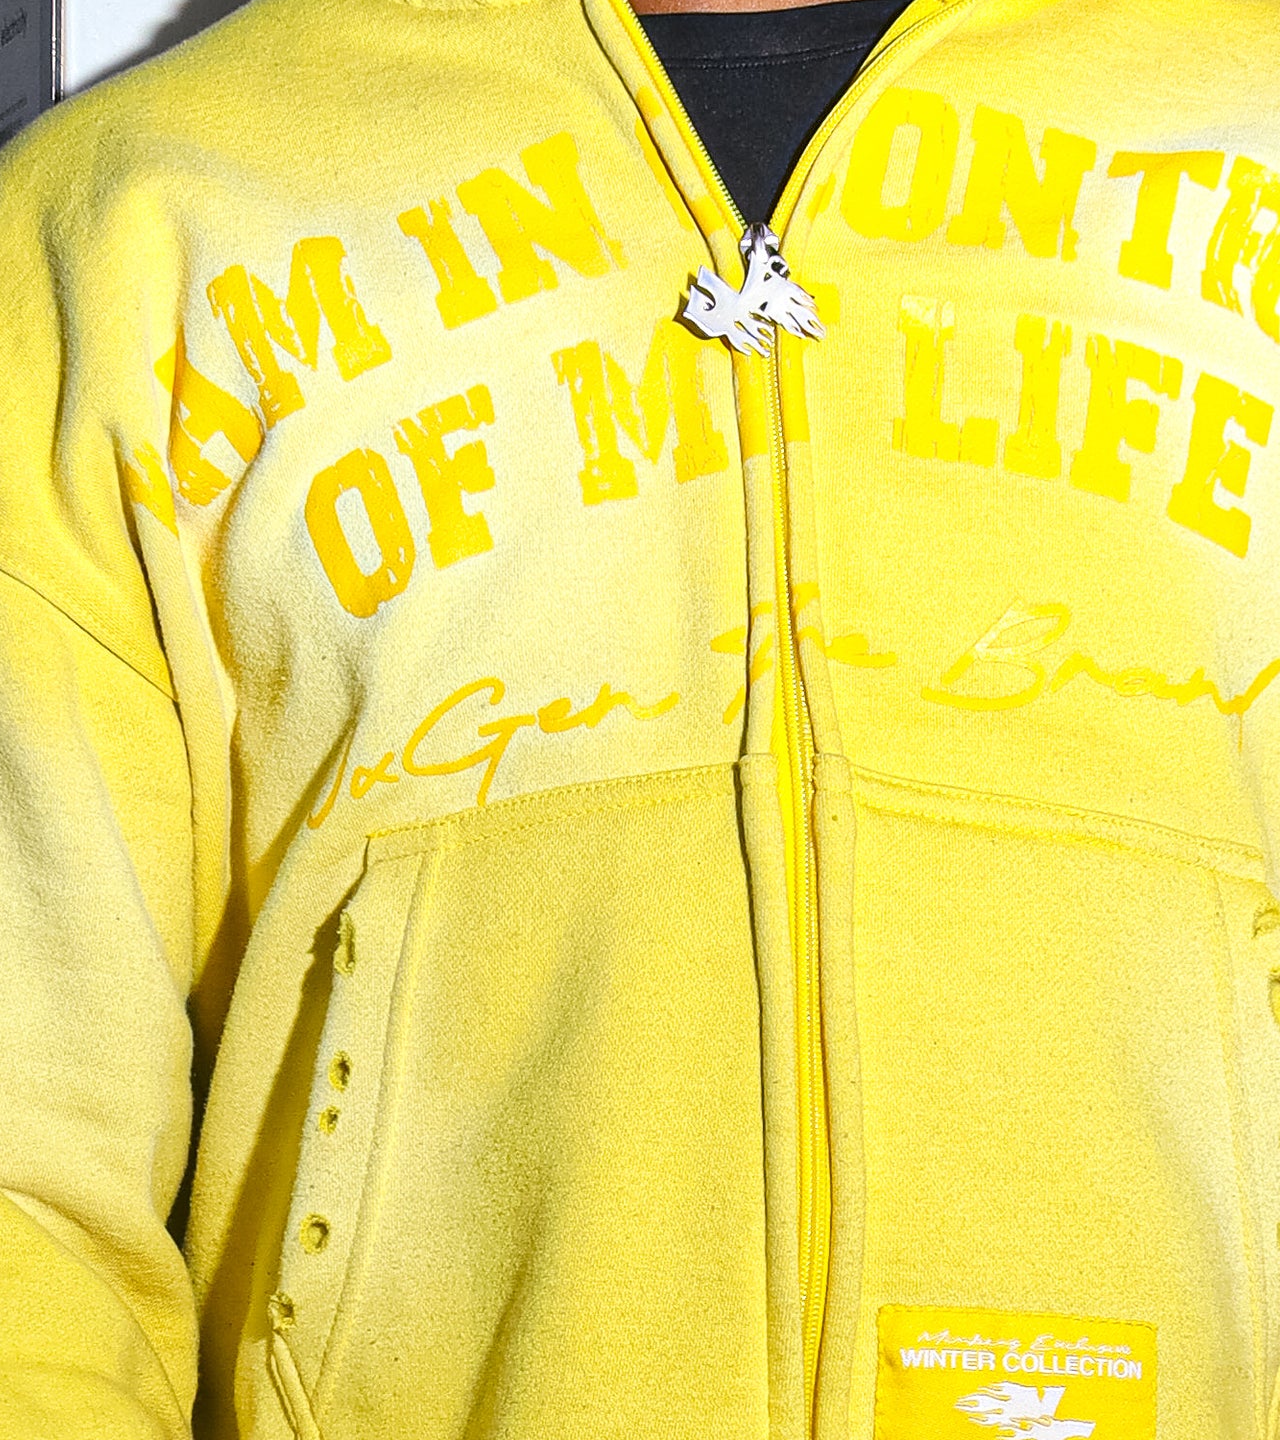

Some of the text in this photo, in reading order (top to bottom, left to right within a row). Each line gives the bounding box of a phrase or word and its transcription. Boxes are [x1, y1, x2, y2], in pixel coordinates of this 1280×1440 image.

[396, 131, 630, 330] IN
[304, 382, 497, 619] OF
[891, 293, 1277, 560] LIFE
[899, 1347, 1143, 1381] WINTER COLLECTION
